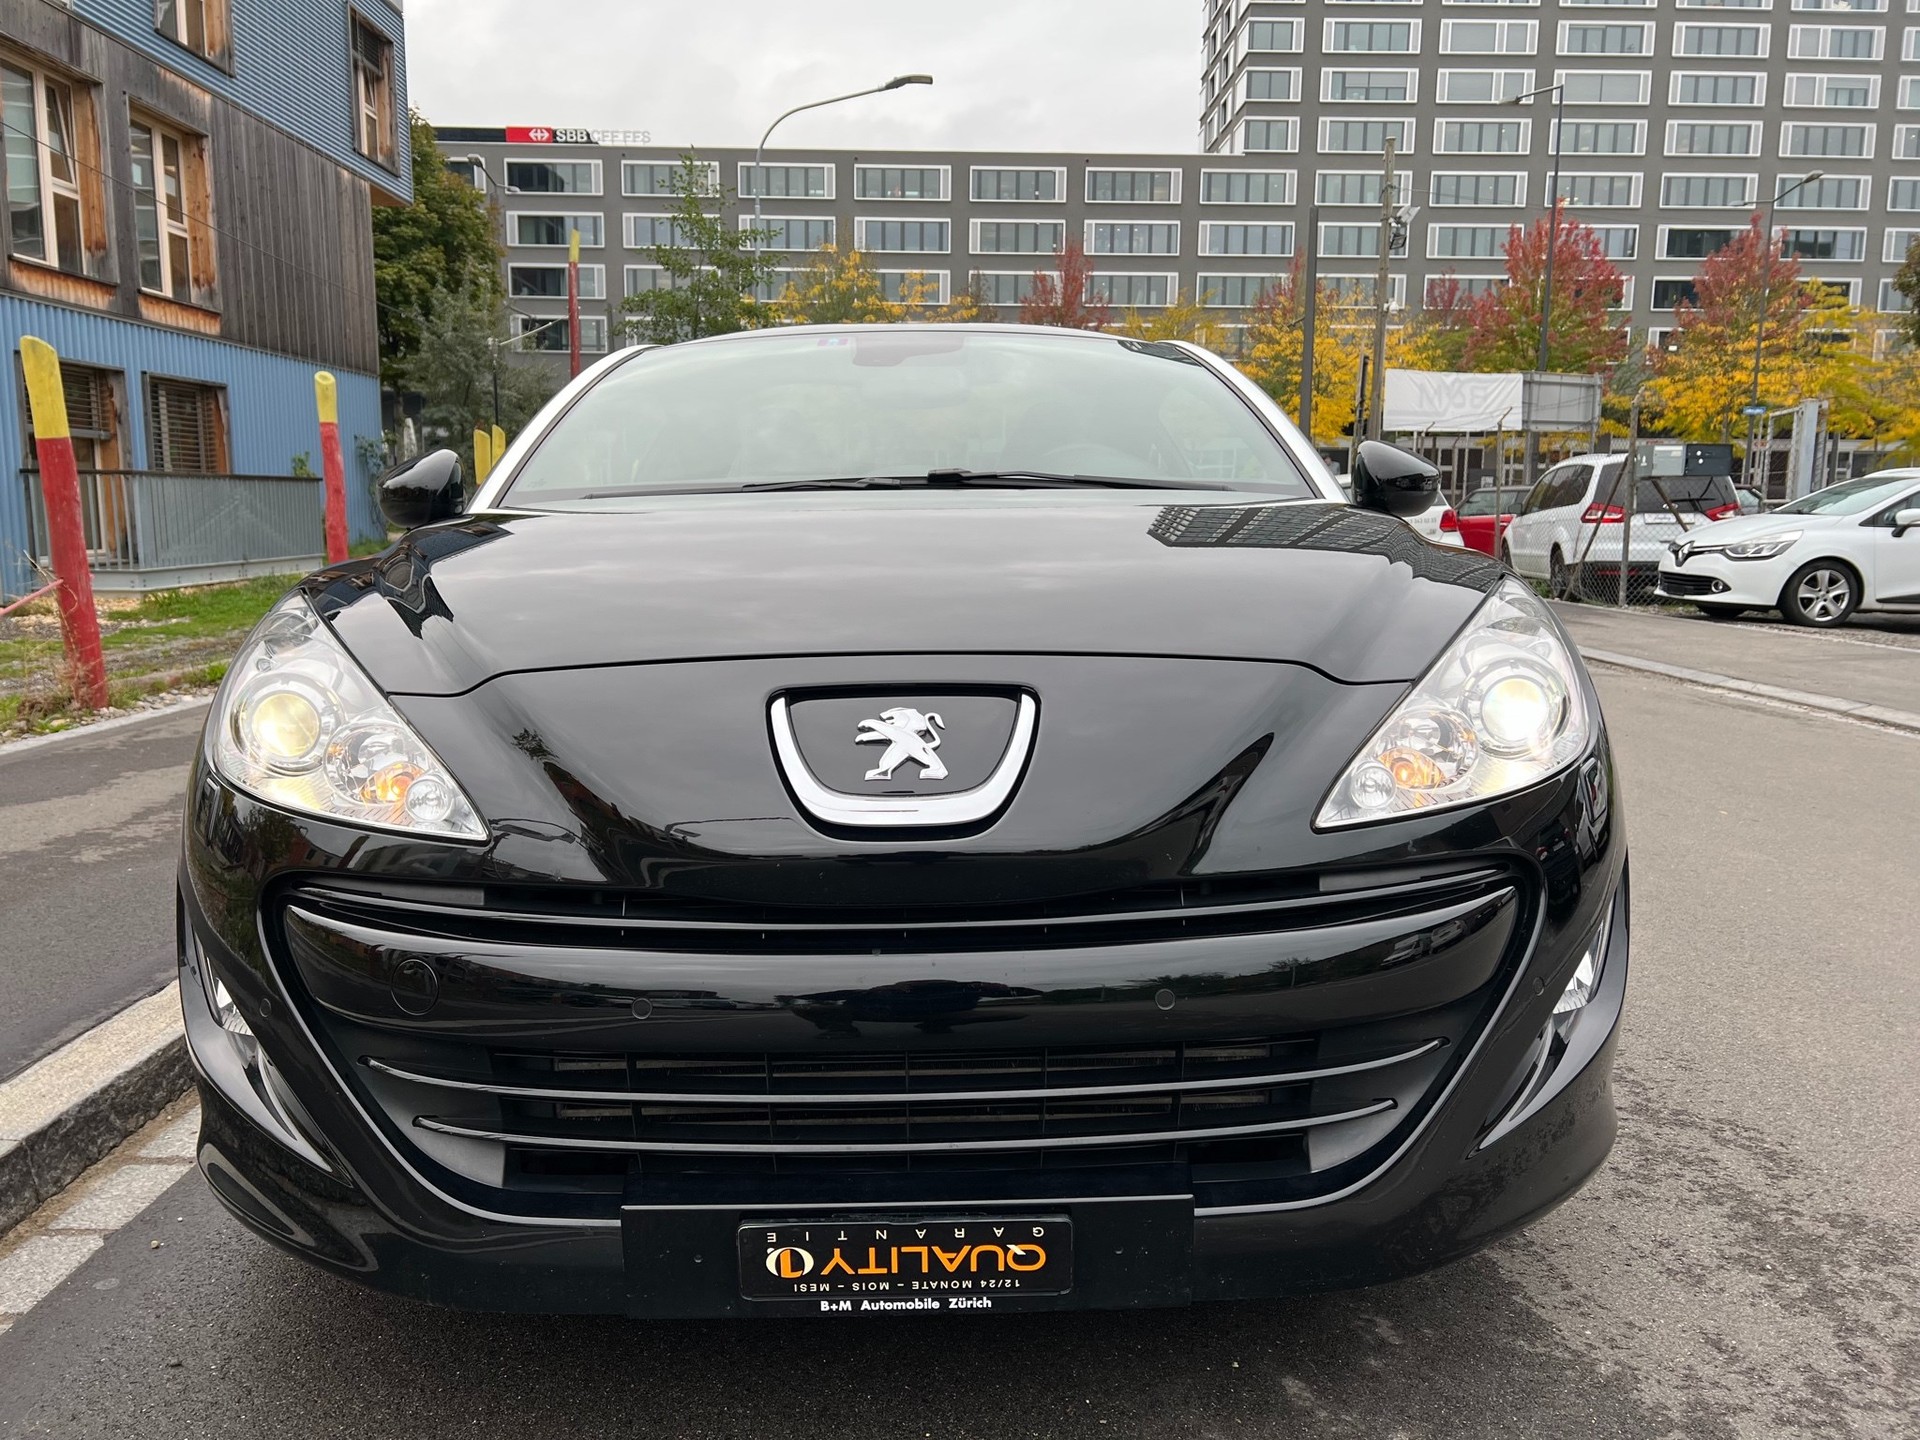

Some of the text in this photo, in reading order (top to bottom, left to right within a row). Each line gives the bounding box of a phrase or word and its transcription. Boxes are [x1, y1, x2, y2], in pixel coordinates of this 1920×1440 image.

[555, 128, 588, 143] SBB
[766, 1226, 1046, 1243] GARANTIE
[793, 1283, 831, 1293] MESI
[851, 1281, 890, 1292] MOIS
[911, 1280, 973, 1291] MONATE
[980, 1279, 1021, 1289] 12/24
[820, 1296, 992, 1312] B+M Automobile Zürich
